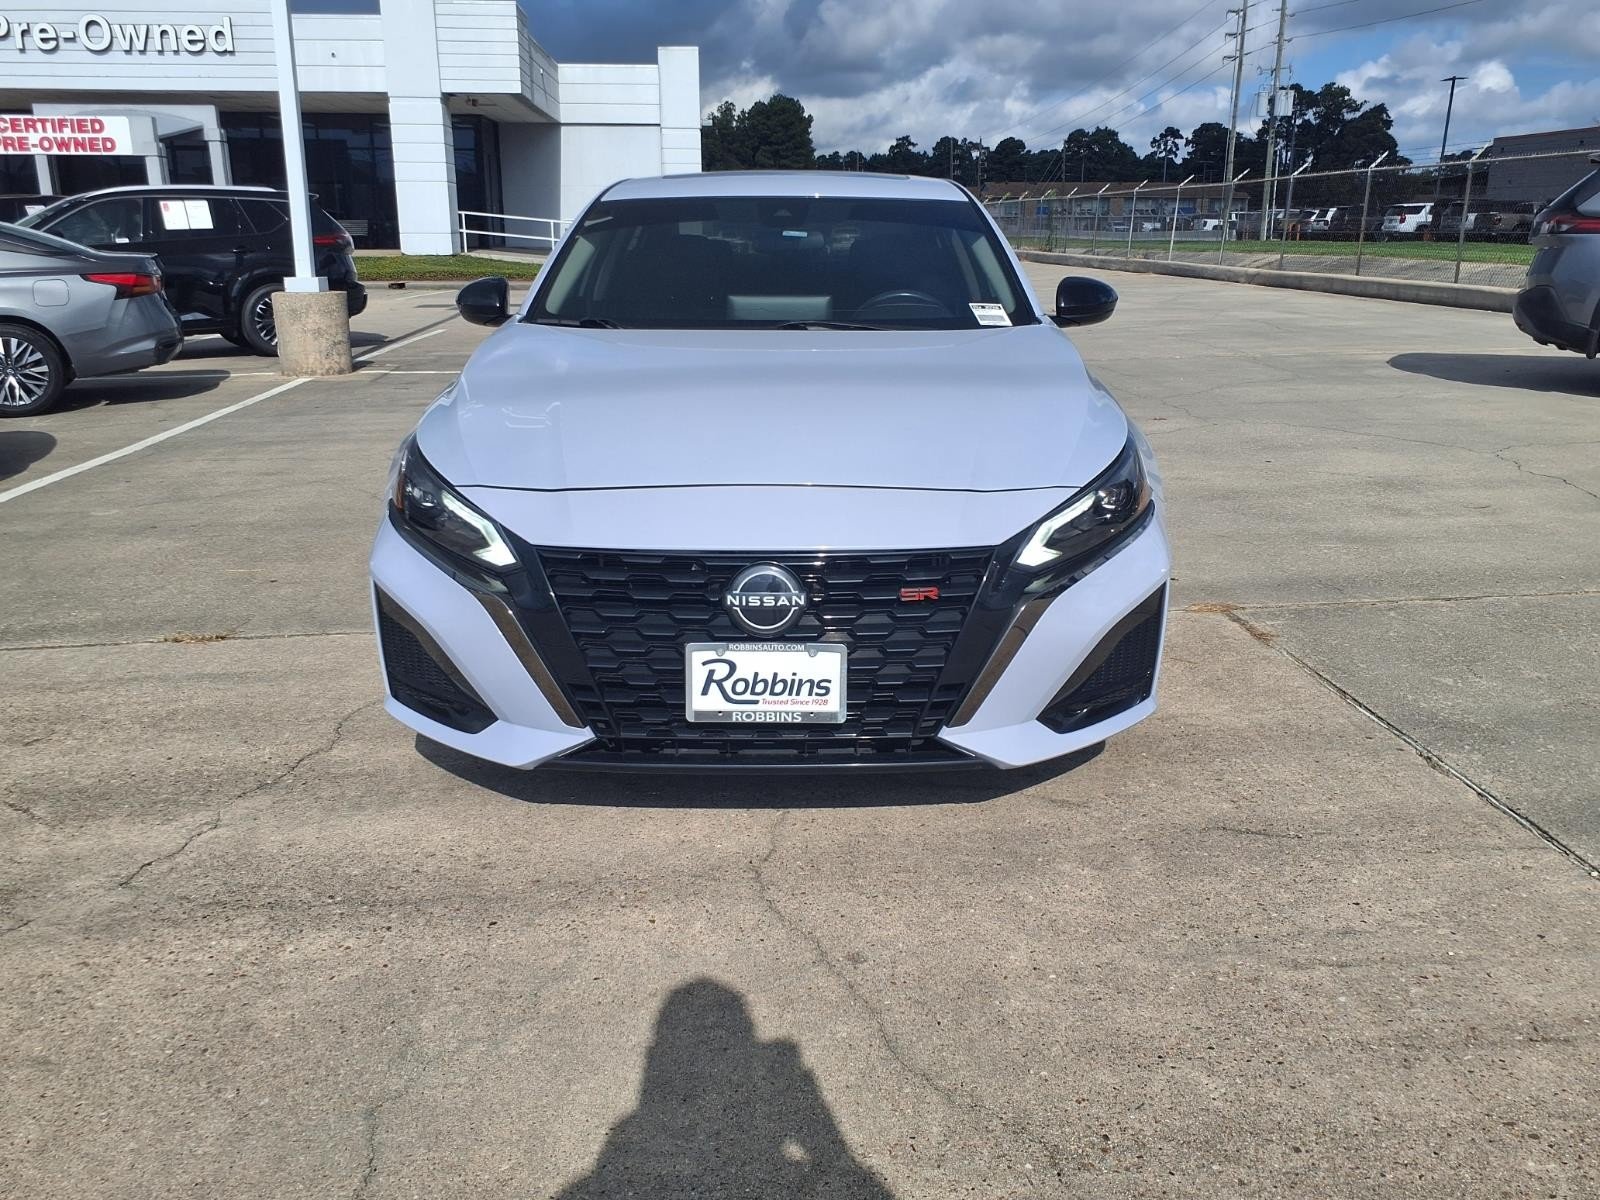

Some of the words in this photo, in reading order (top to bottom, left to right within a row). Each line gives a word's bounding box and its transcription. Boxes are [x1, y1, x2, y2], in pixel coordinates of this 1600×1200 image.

[0, 117, 105, 134] CERTIFIED
[0, 136, 117, 153] RE-OWNED
[727, 594, 805, 606] NISSAN
[900, 587, 939, 601] SR
[728, 644, 805, 652] ROBBINSAUTO.COM
[700, 658, 832, 705] Robbins
[762, 698, 788, 706] Trusted
[790, 698, 810, 706] Since
[811, 698, 829, 706] 1928
[732, 711, 802, 722] ROBBINS
